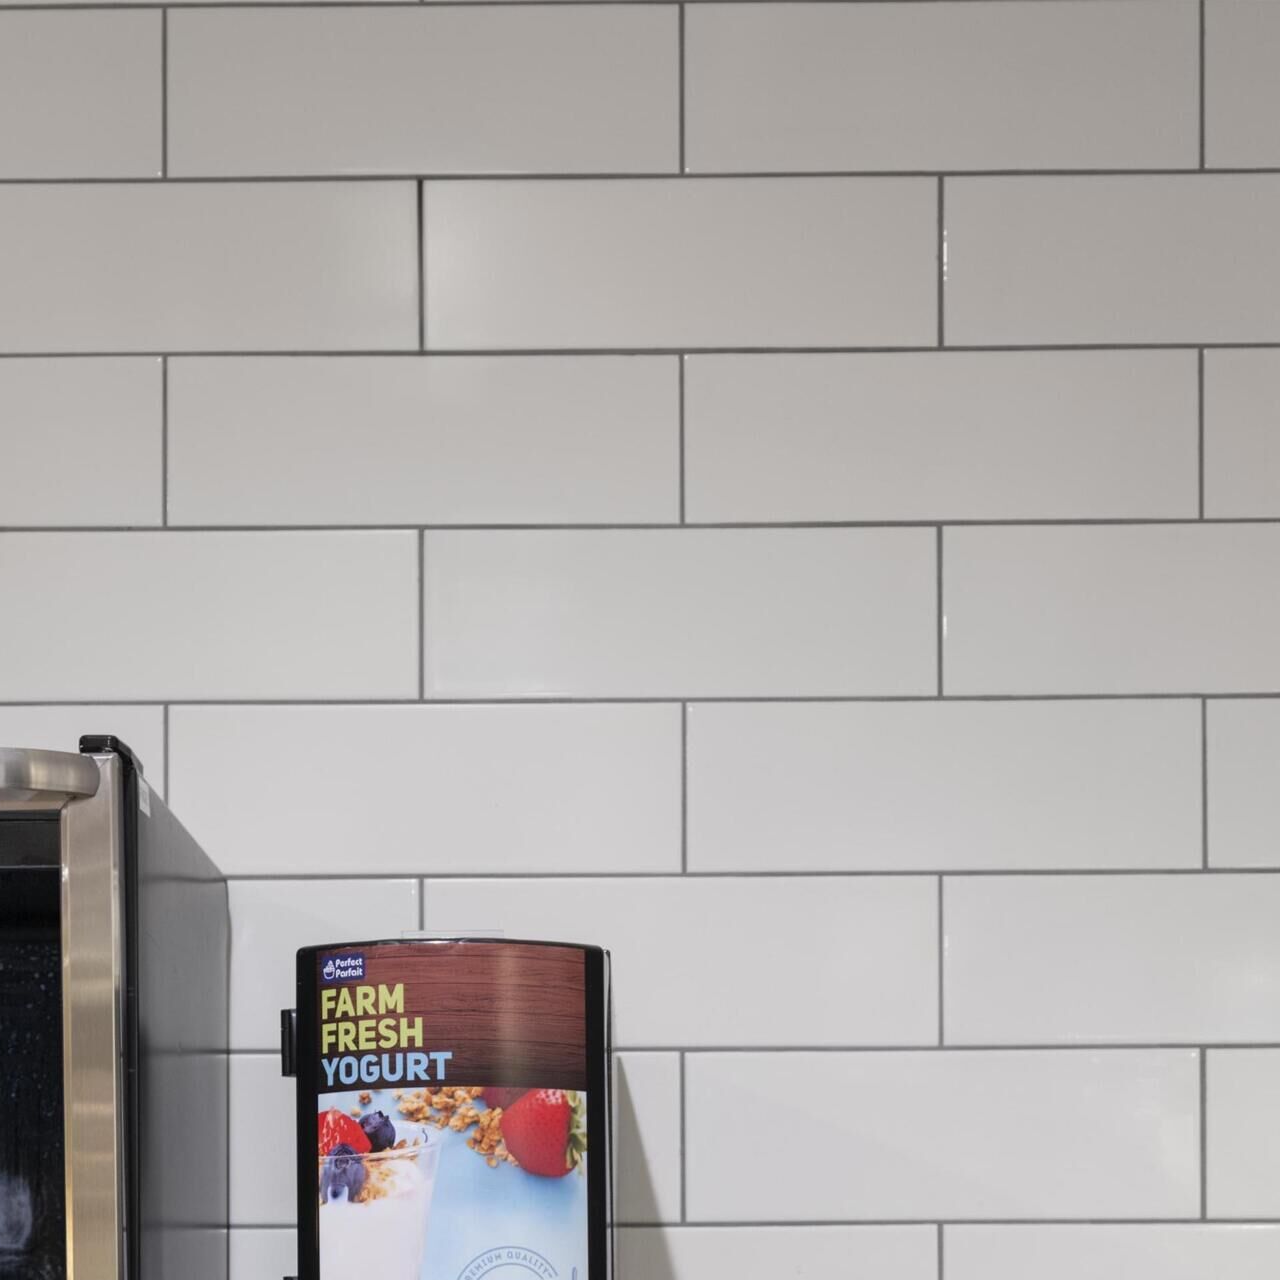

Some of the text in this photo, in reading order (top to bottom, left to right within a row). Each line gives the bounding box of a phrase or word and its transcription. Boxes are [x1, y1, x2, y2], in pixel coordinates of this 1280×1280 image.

[335, 957, 363, 968] Perfect
[335, 967, 363, 978] Parfait
[321, 983, 405, 1020] FARM
[322, 1017, 423, 1054] FRESH
[321, 1051, 453, 1087] YOGURT
[506, 1250, 551, 1276] QUALITY
